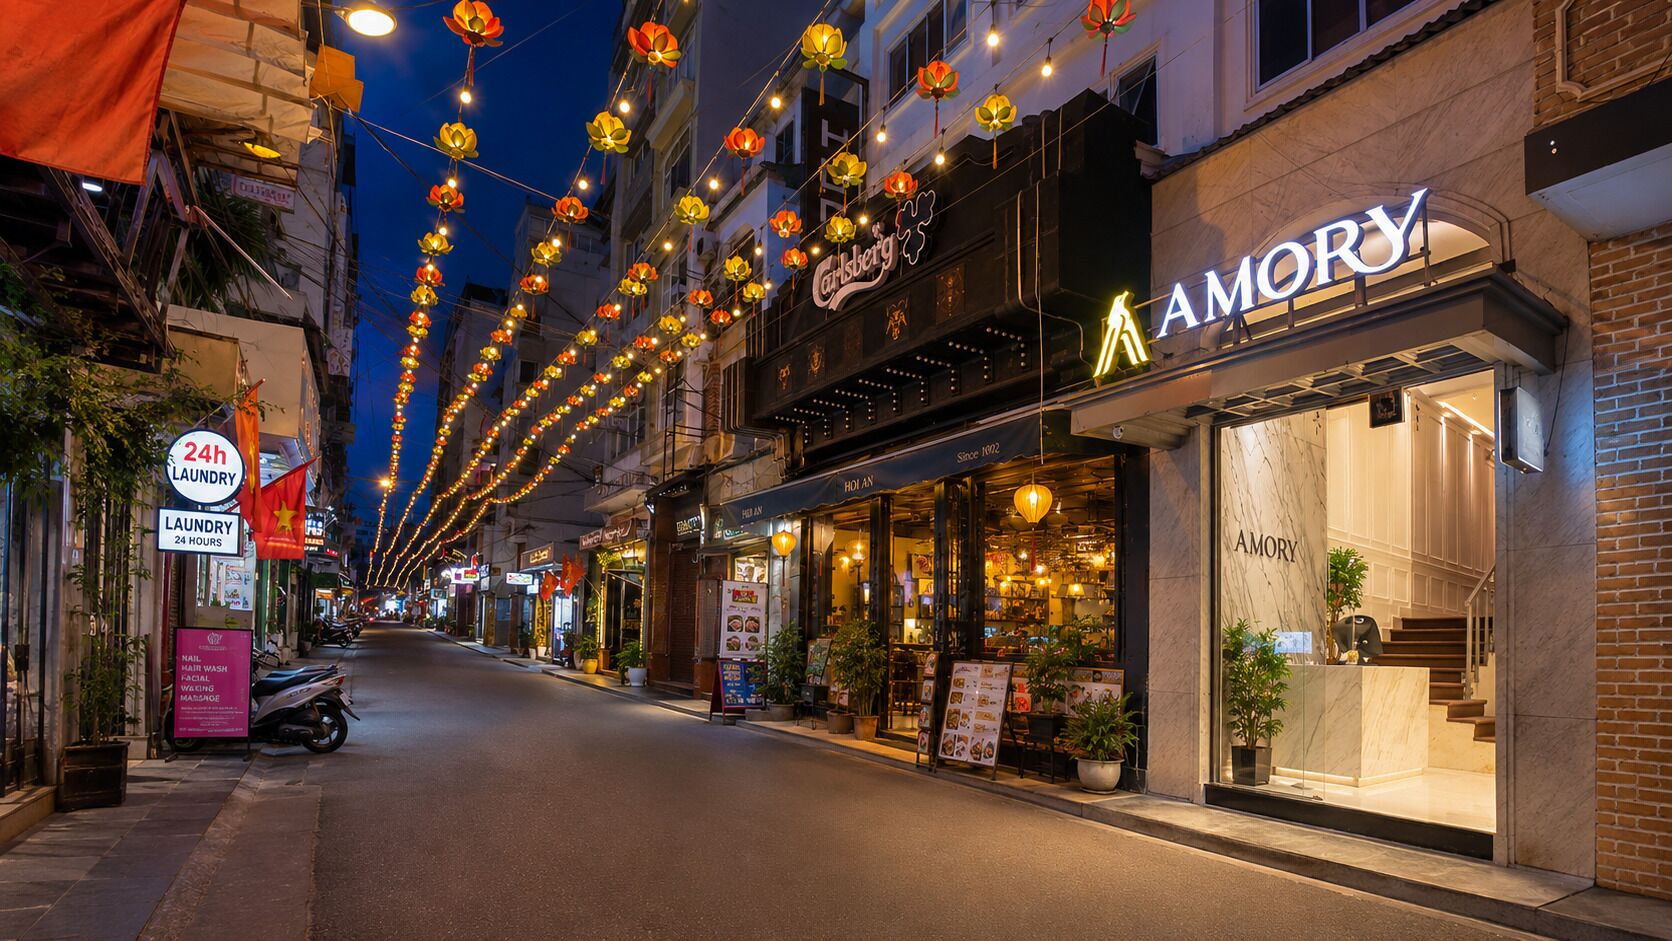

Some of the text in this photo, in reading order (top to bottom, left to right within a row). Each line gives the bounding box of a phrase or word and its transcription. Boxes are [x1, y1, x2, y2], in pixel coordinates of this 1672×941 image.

[812, 233, 898, 310] Carlsberg
[1156, 187, 1432, 338] AMORY
[183, 441, 227, 465] 24h
[957, 450, 979, 463] Since
[172, 466, 236, 487] LAUNDRY
[844, 474, 874, 493] HOI AN
[165, 516, 233, 536] LAUNDRY
[174, 536, 222, 548] 24 HOURS
[1233, 529, 1298, 563] AMORY
[181, 655, 201, 663] NAIL
[203, 665, 228, 673] WASH
